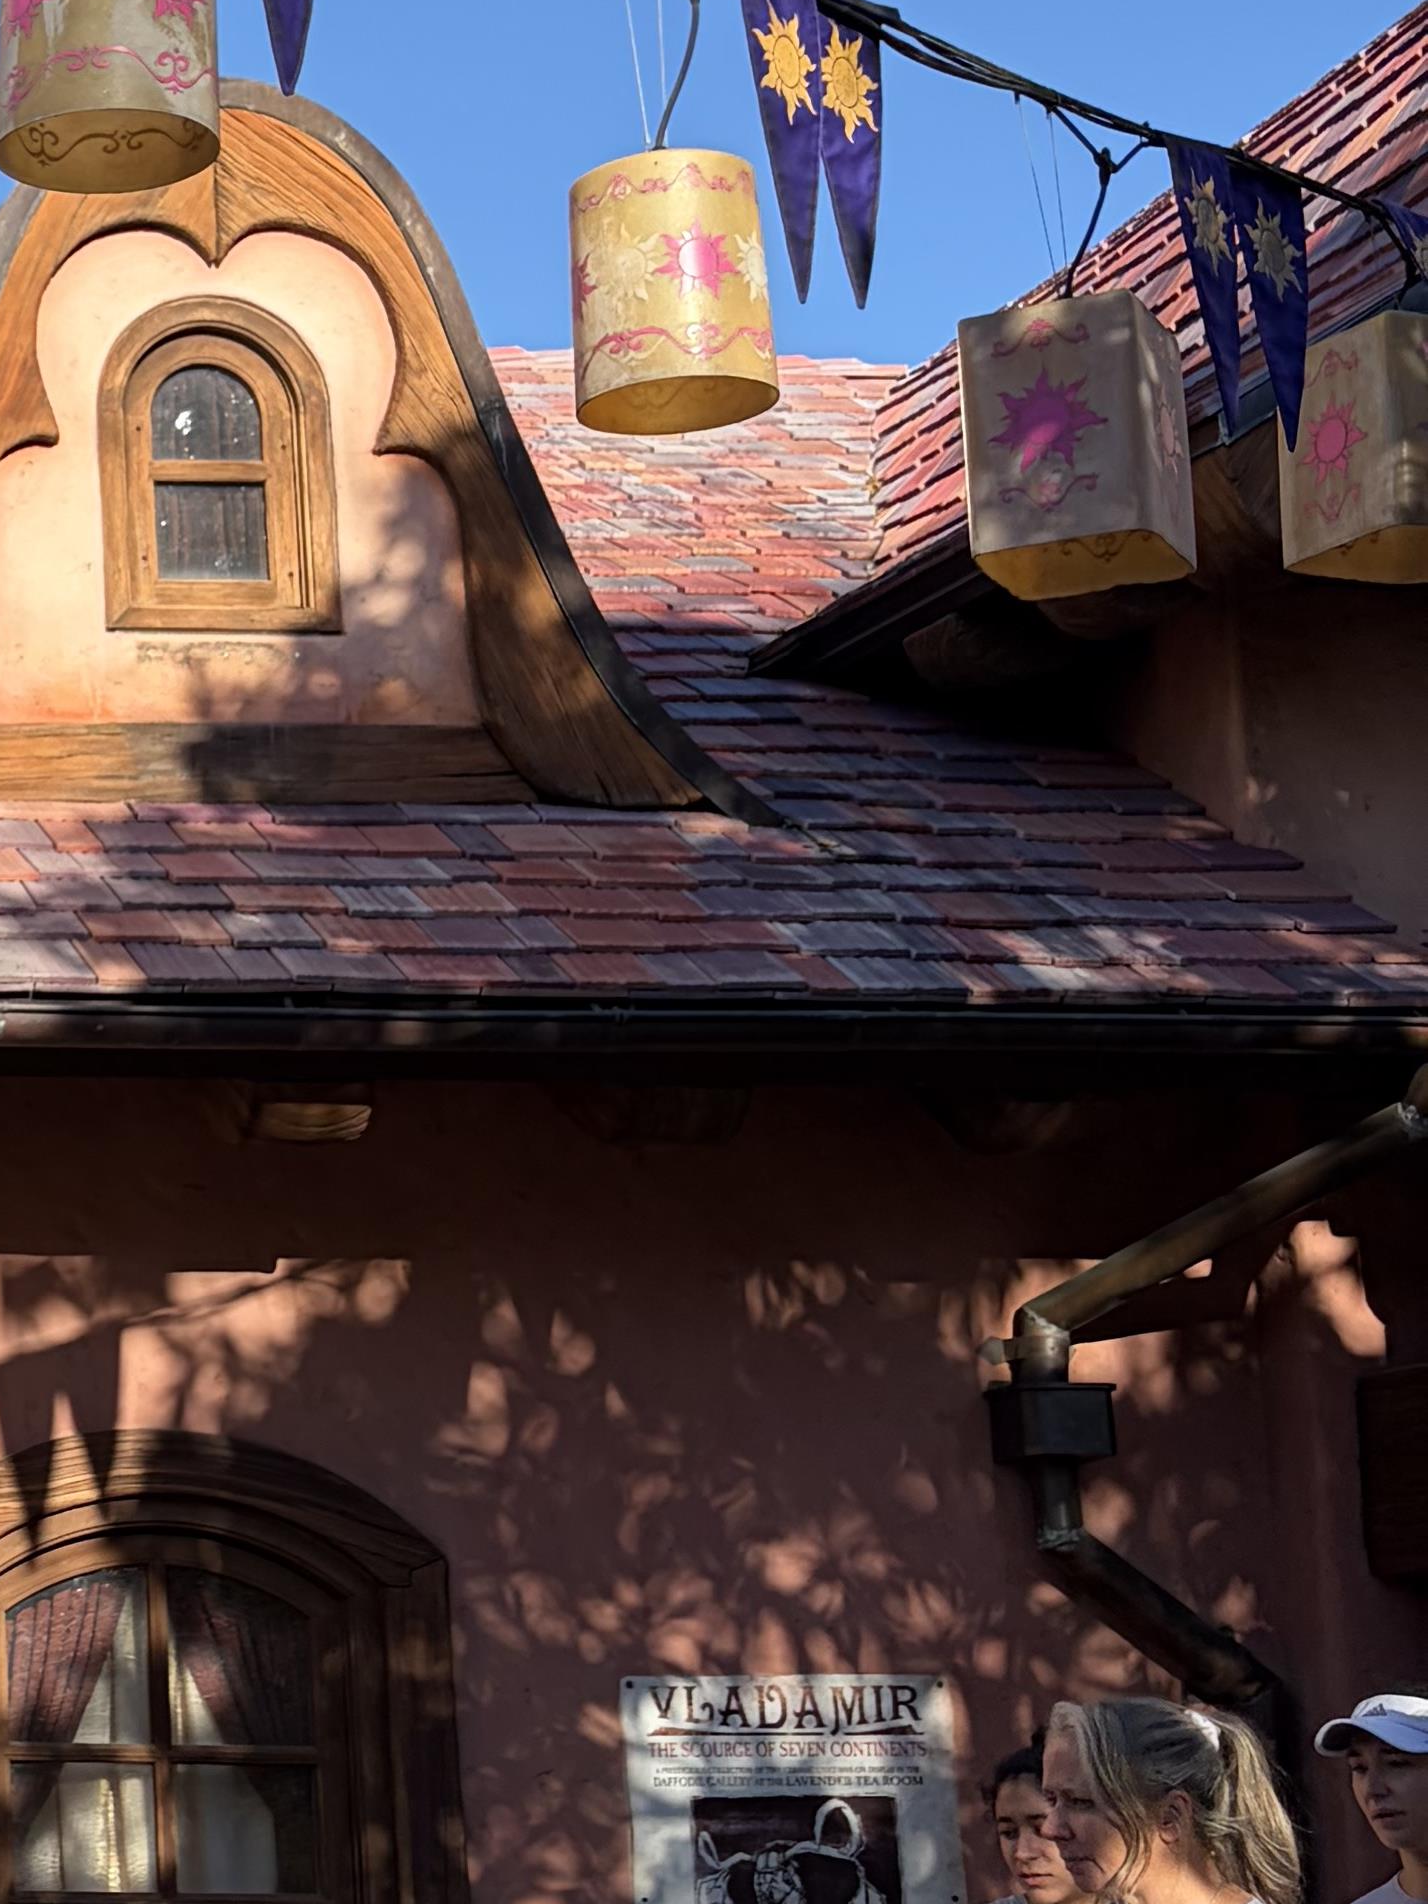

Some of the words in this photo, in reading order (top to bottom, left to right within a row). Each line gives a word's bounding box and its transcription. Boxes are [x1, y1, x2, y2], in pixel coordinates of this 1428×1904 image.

[647, 1683, 923, 1736] VLADAMIR
[648, 1741, 677, 1758] THE
[681, 1741, 753, 1758] SCOURGE
[756, 1741, 776, 1758] OF
[779, 1741, 826, 1758] SEVEN
[830, 1740, 928, 1758] CONTINENTS
